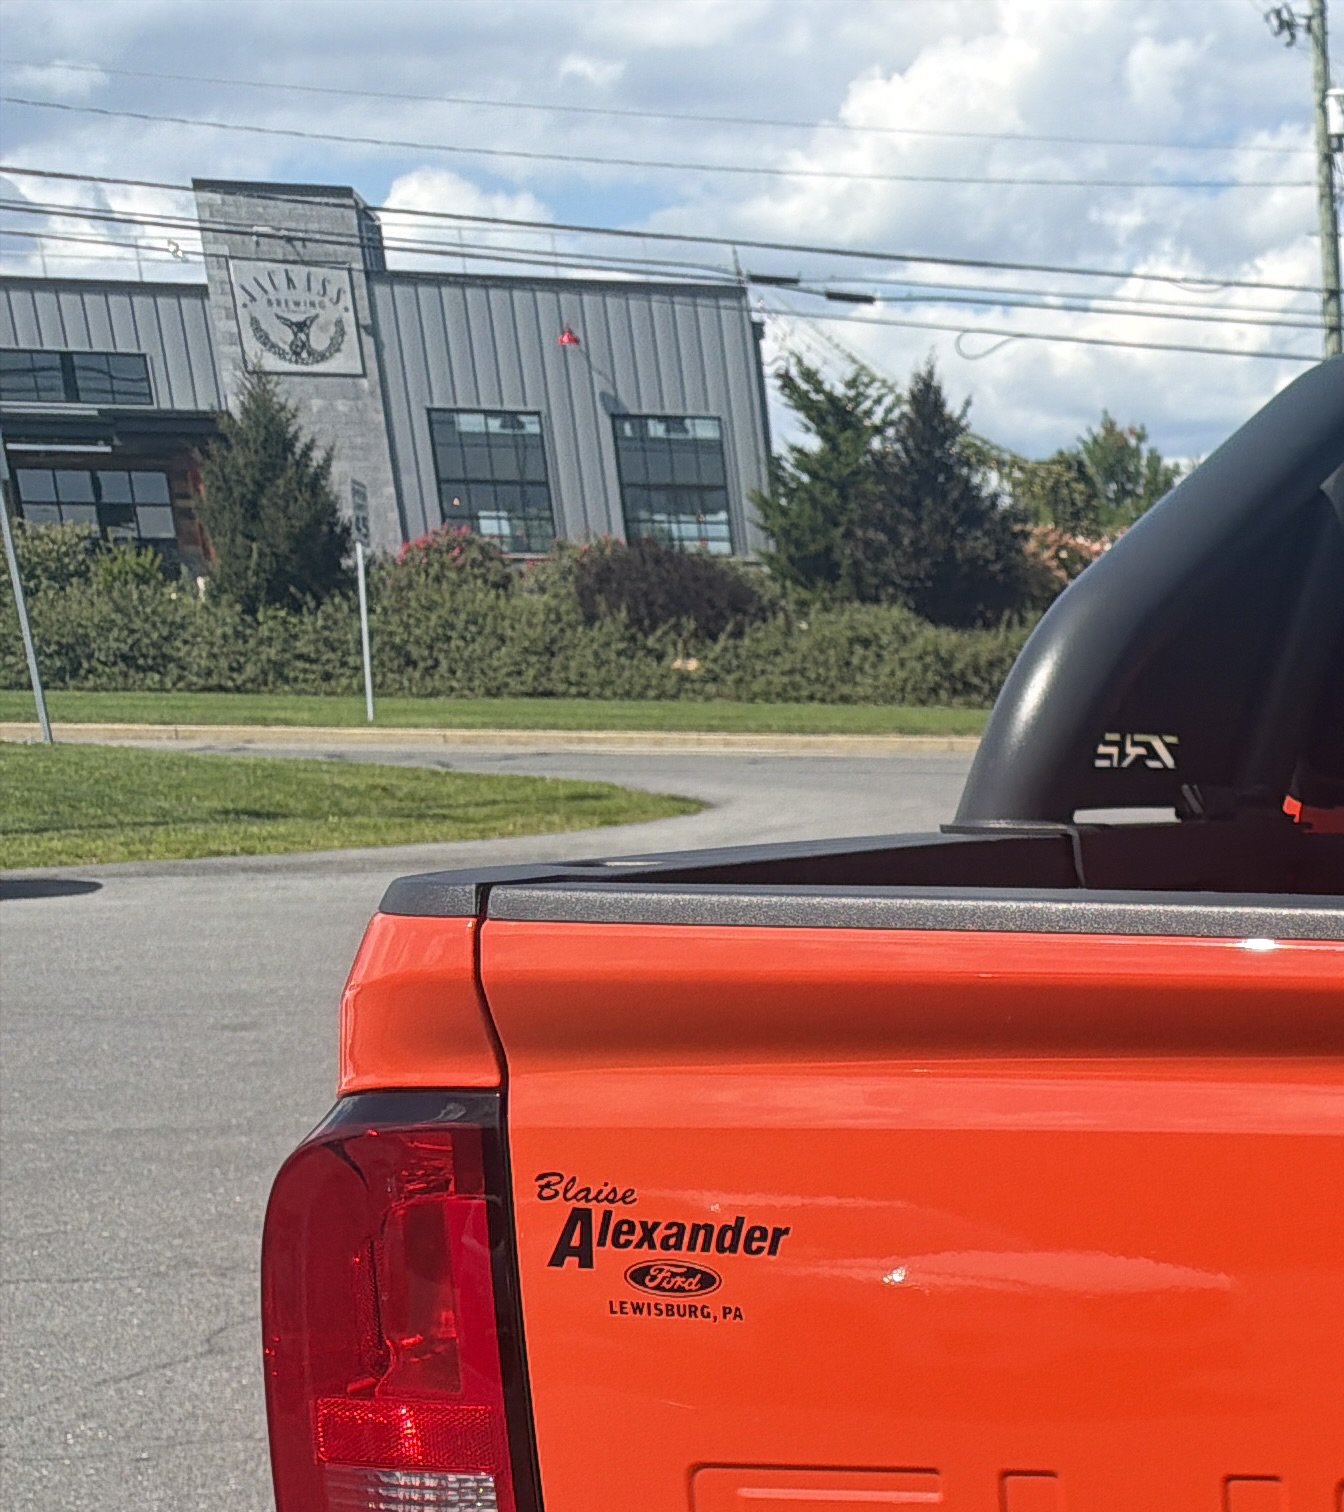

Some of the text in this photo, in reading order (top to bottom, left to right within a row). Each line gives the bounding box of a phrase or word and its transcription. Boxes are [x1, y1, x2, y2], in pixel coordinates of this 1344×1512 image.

[534, 1172, 638, 1204] Blaise
[547, 1207, 791, 1270] Alexander
[643, 1265, 703, 1292] Ford
[608, 1300, 744, 1323] LEWISBURG, PA
